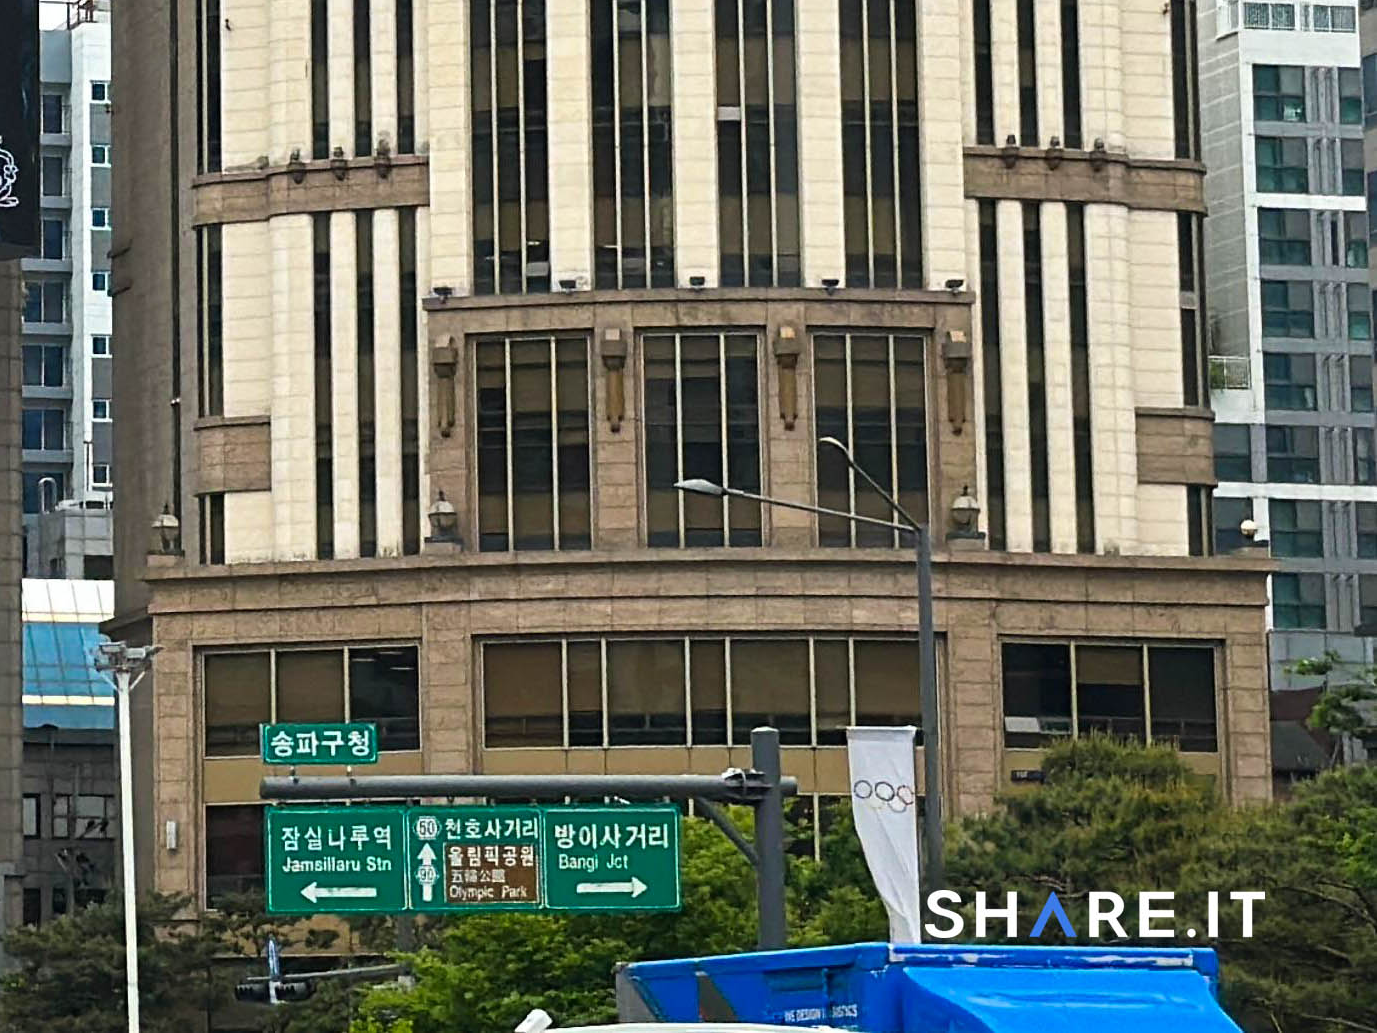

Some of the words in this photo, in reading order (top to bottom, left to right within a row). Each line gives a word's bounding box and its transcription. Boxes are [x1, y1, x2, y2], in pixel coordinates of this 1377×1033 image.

[271, 730, 370, 757] 송파구청
[281, 825, 392, 851] 잠실나루역
[445, 817, 539, 840] 천호사거리
[554, 823, 669, 849] 방이사거리
[282, 856, 360, 872] Jamsillaru
[366, 856, 392, 872] Stn
[448, 845, 534, 867] 올림픽공원
[558, 853, 599, 872] Bangi
[606, 853, 628, 869] Jct
[449, 885, 494, 900] Olympic
[502, 885, 527, 898] Park
